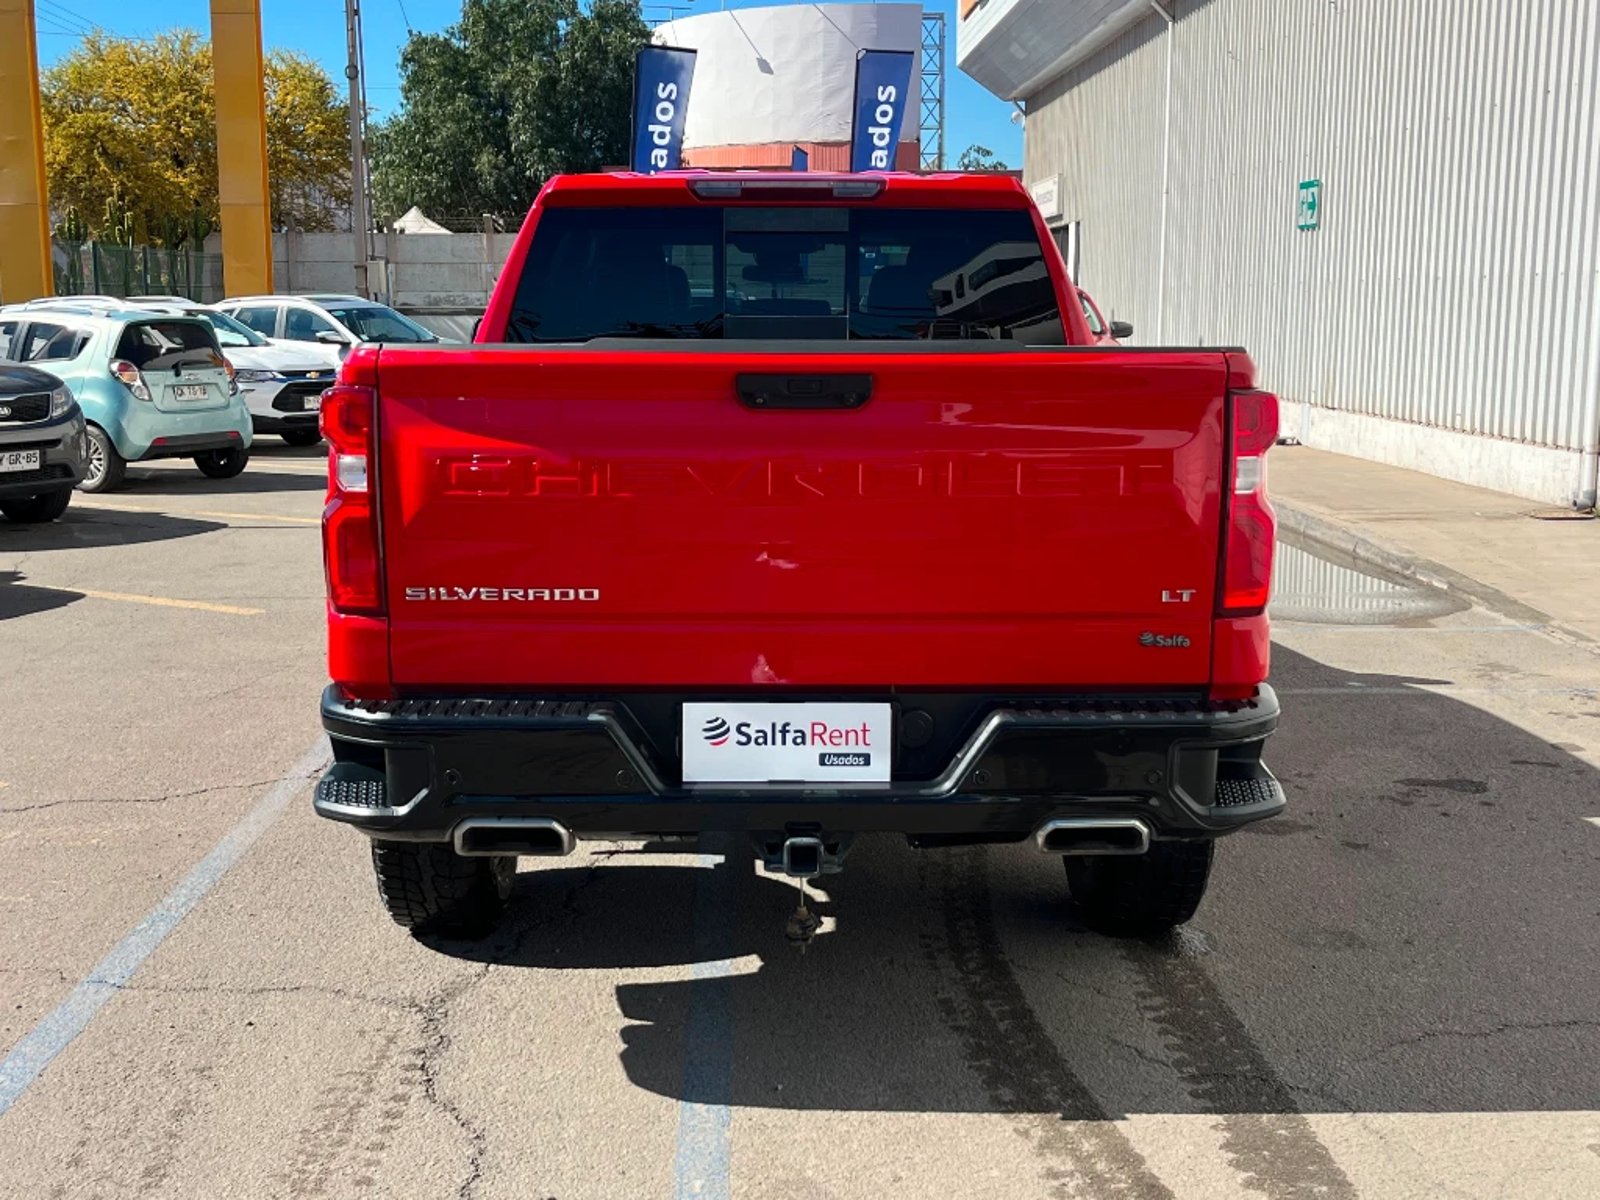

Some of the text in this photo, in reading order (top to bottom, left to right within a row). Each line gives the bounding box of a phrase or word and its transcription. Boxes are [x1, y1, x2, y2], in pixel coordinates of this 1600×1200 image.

[648, 82, 677, 175] ados
[868, 85, 896, 168] ados
[405, 586, 600, 601] SILVERADO
[1161, 588, 1197, 602] LT
[1155, 635, 1191, 648] Salfa
[735, 721, 871, 747] SalfaRent
[824, 754, 865, 766] Usados
